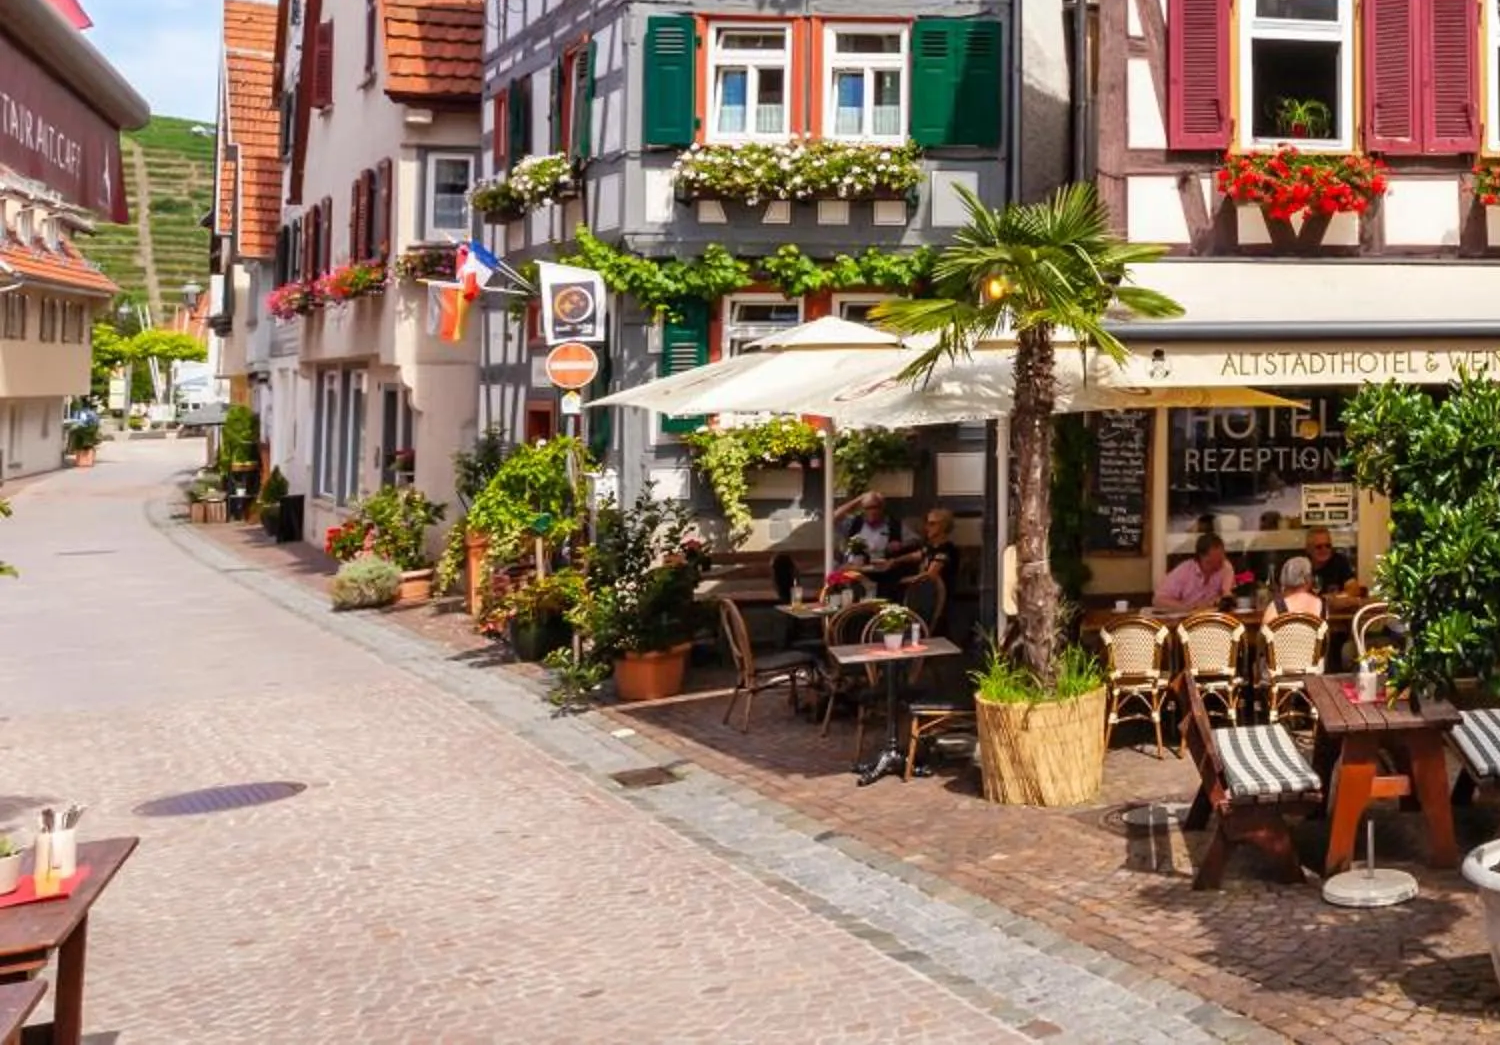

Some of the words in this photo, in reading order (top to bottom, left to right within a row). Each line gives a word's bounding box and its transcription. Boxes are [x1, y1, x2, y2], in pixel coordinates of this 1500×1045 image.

[1221, 350, 1418, 376] ALTSTADTHOTEL
[1425, 350, 1440, 373] &
[1185, 398, 1341, 440] HOTEL
[1184, 446, 1342, 473] REZEPTION
